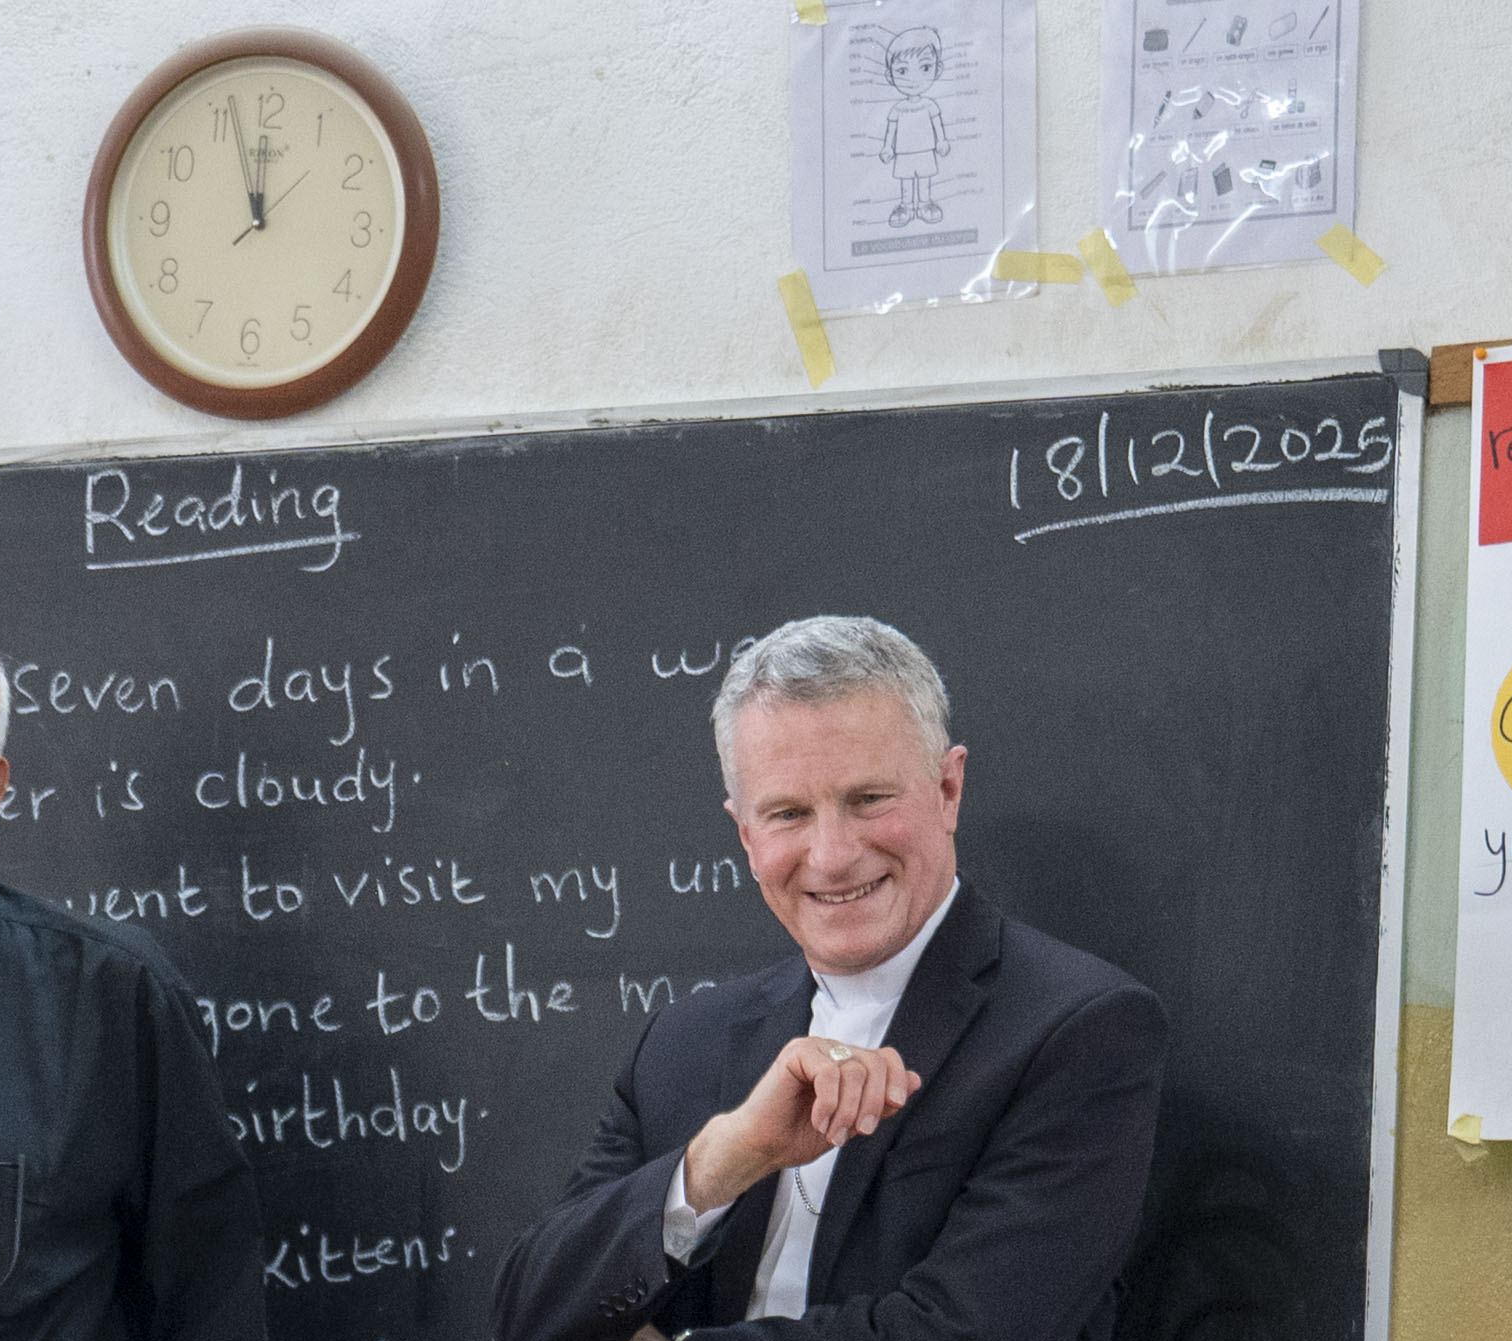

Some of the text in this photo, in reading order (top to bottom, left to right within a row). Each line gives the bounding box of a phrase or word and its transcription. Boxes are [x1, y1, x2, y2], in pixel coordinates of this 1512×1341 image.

[212, 109, 229, 142] 11
[258, 92, 285, 130] 12
[315, 114, 323, 146] 1
[167, 144, 195, 182] 10
[342, 155, 364, 191] 2
[150, 201, 171, 236] 9
[351, 211, 371, 248] 3
[158, 257, 179, 295] 8
[332, 269, 352, 302] 4
[195, 300, 213, 333] 7
[290, 306, 312, 341] 5
[240, 319, 260, 355] 6
[1009, 411, 1393, 509] 18/12/2025
[85, 466, 342, 572] Reading
[15, 662, 181, 716] seven
[229, 638, 395, 745] days
[440, 632, 498, 692] in
[95, 761, 144, 820] is
[196, 751, 421, 832] cloudy.
[241, 855, 304, 921] to
[335, 856, 486, 908] visit
[532, 868, 620, 939] my
[367, 970, 441, 1034] to
[466, 943, 576, 1022] the
